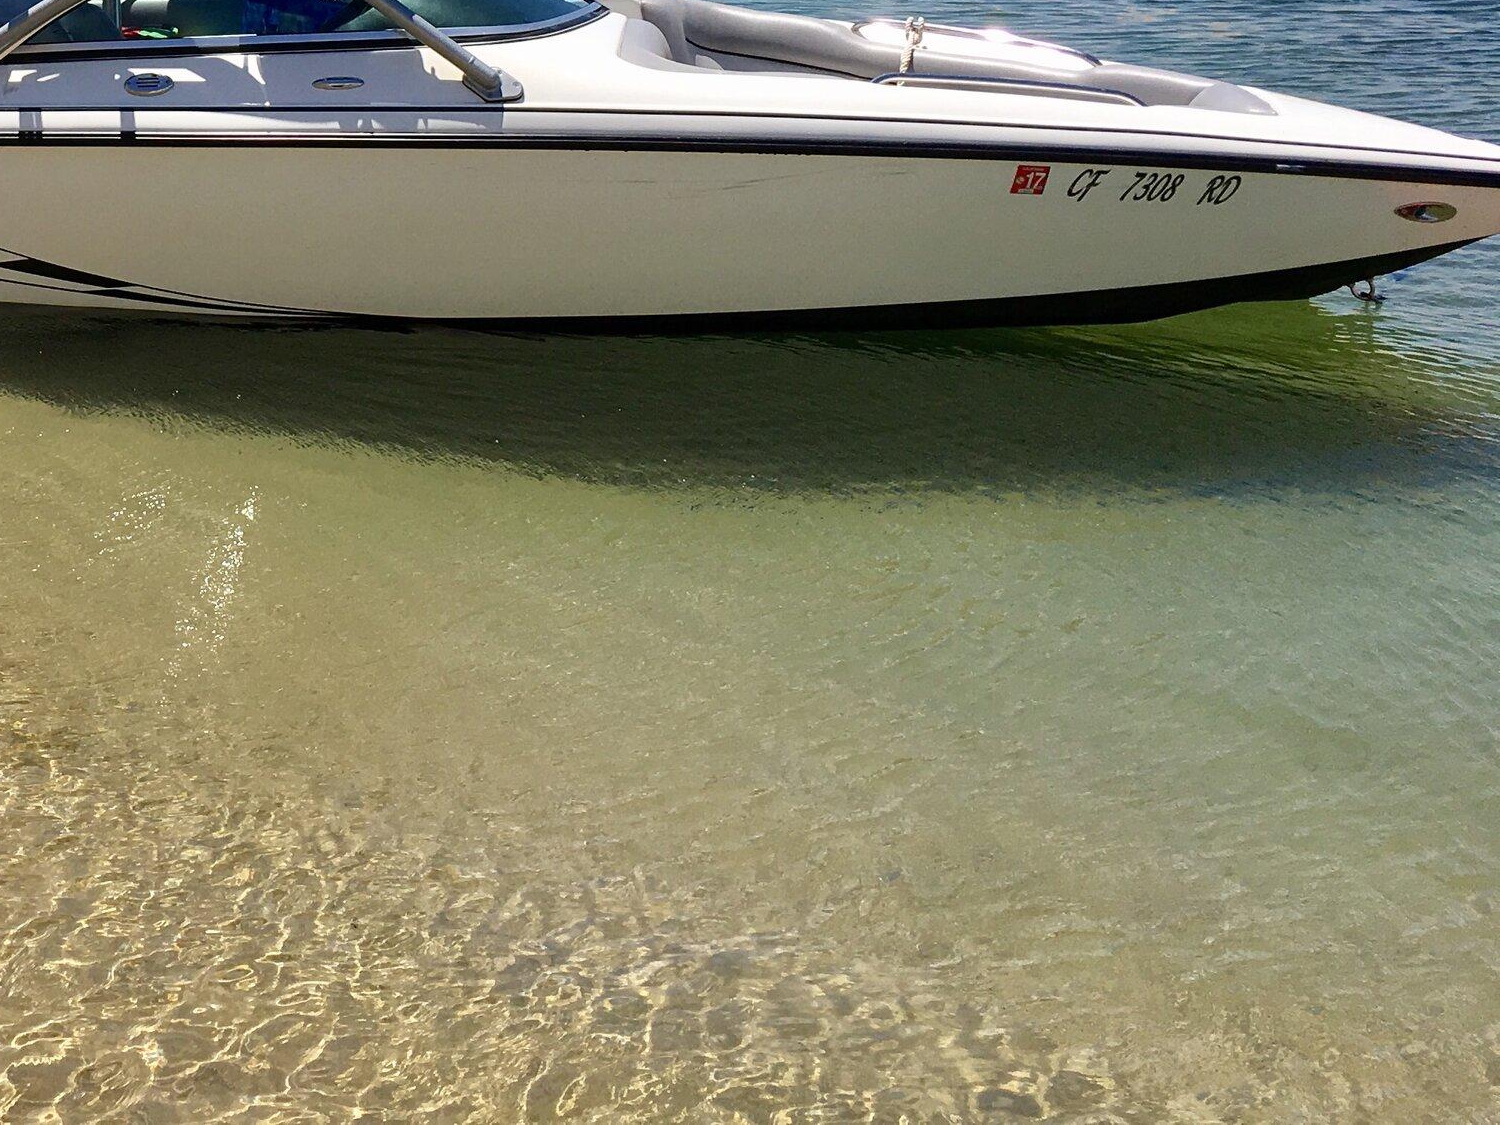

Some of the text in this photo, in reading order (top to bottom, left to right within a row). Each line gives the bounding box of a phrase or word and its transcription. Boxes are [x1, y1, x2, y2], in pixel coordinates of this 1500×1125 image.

[1026, 171, 1047, 189] 17
[1066, 168, 1242, 205] CF 7308 RD
